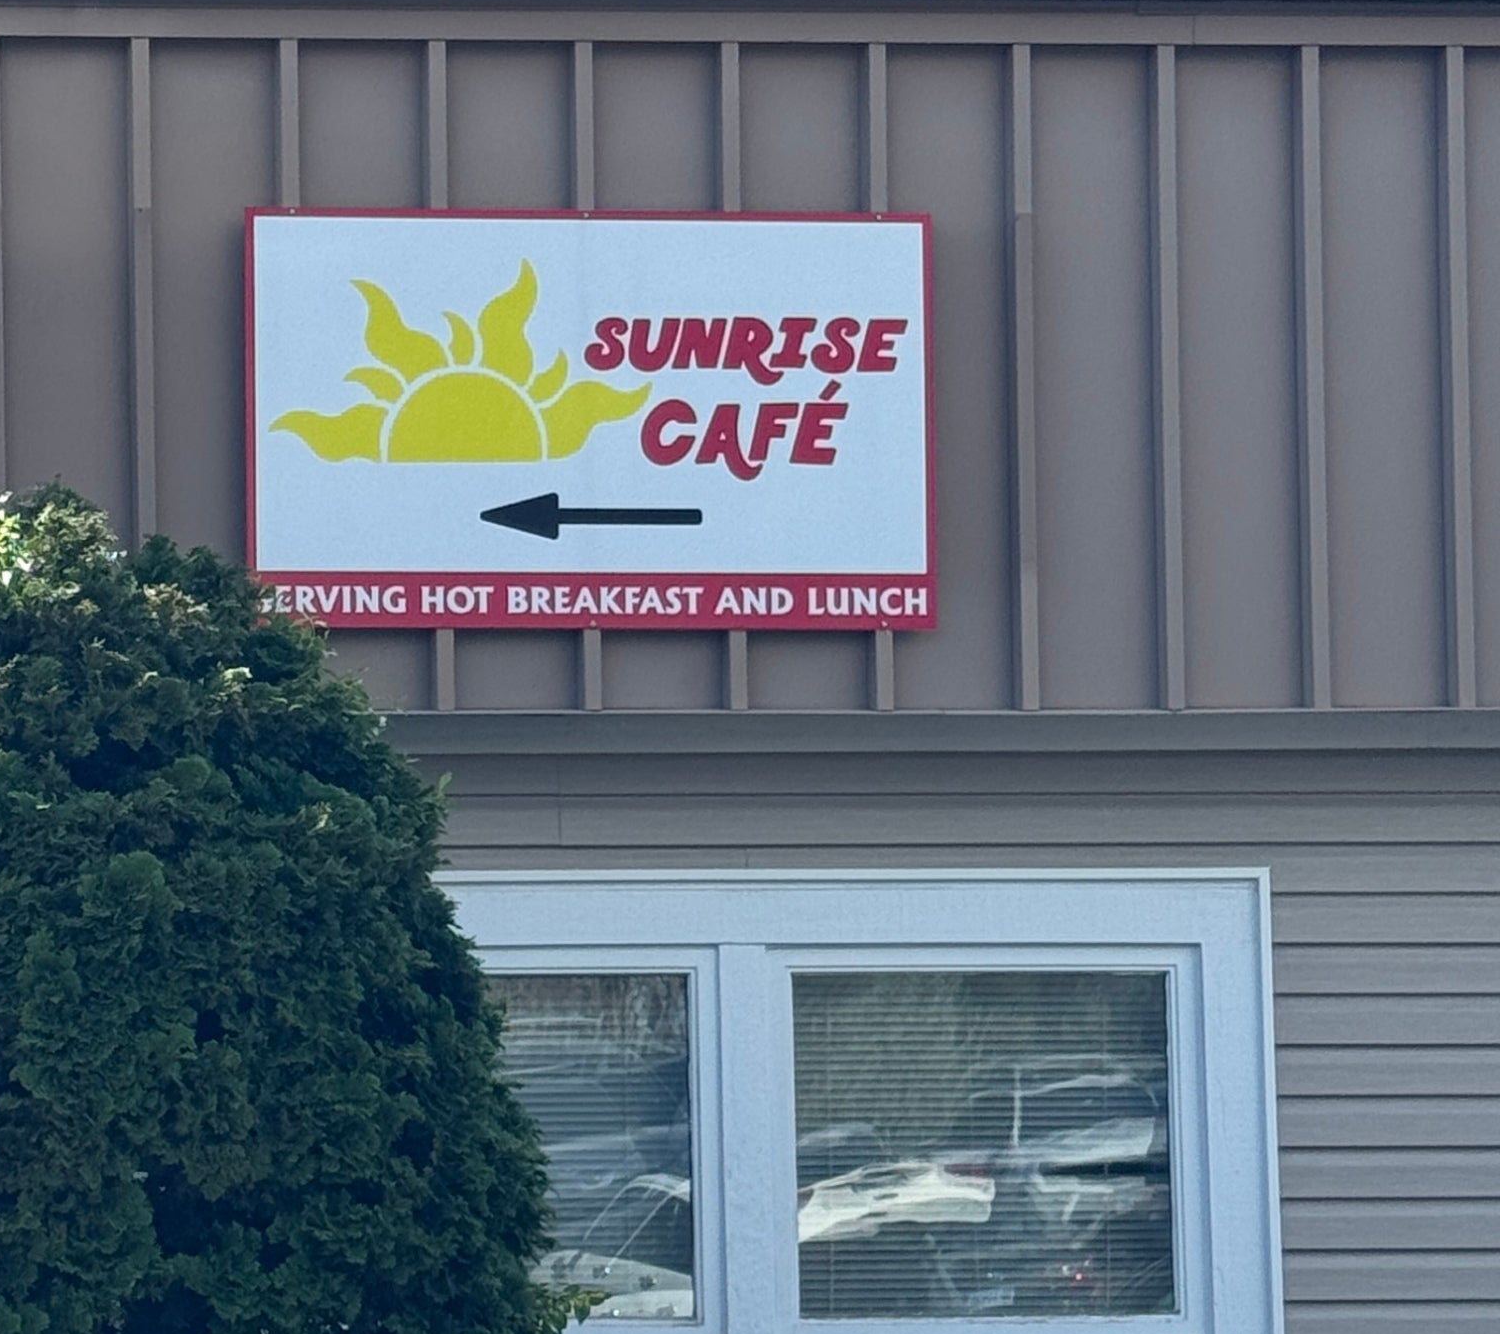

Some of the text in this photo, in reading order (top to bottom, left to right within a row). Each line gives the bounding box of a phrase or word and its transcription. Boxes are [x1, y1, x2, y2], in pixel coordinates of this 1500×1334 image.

[584, 316, 908, 386] SUNRISE
[640, 379, 849, 481] CAFÉ
[421, 585, 494, 613] HOT
[507, 586, 704, 615] BREAKFAST
[714, 587, 794, 615] AND
[808, 587, 927, 616] LUNCH
